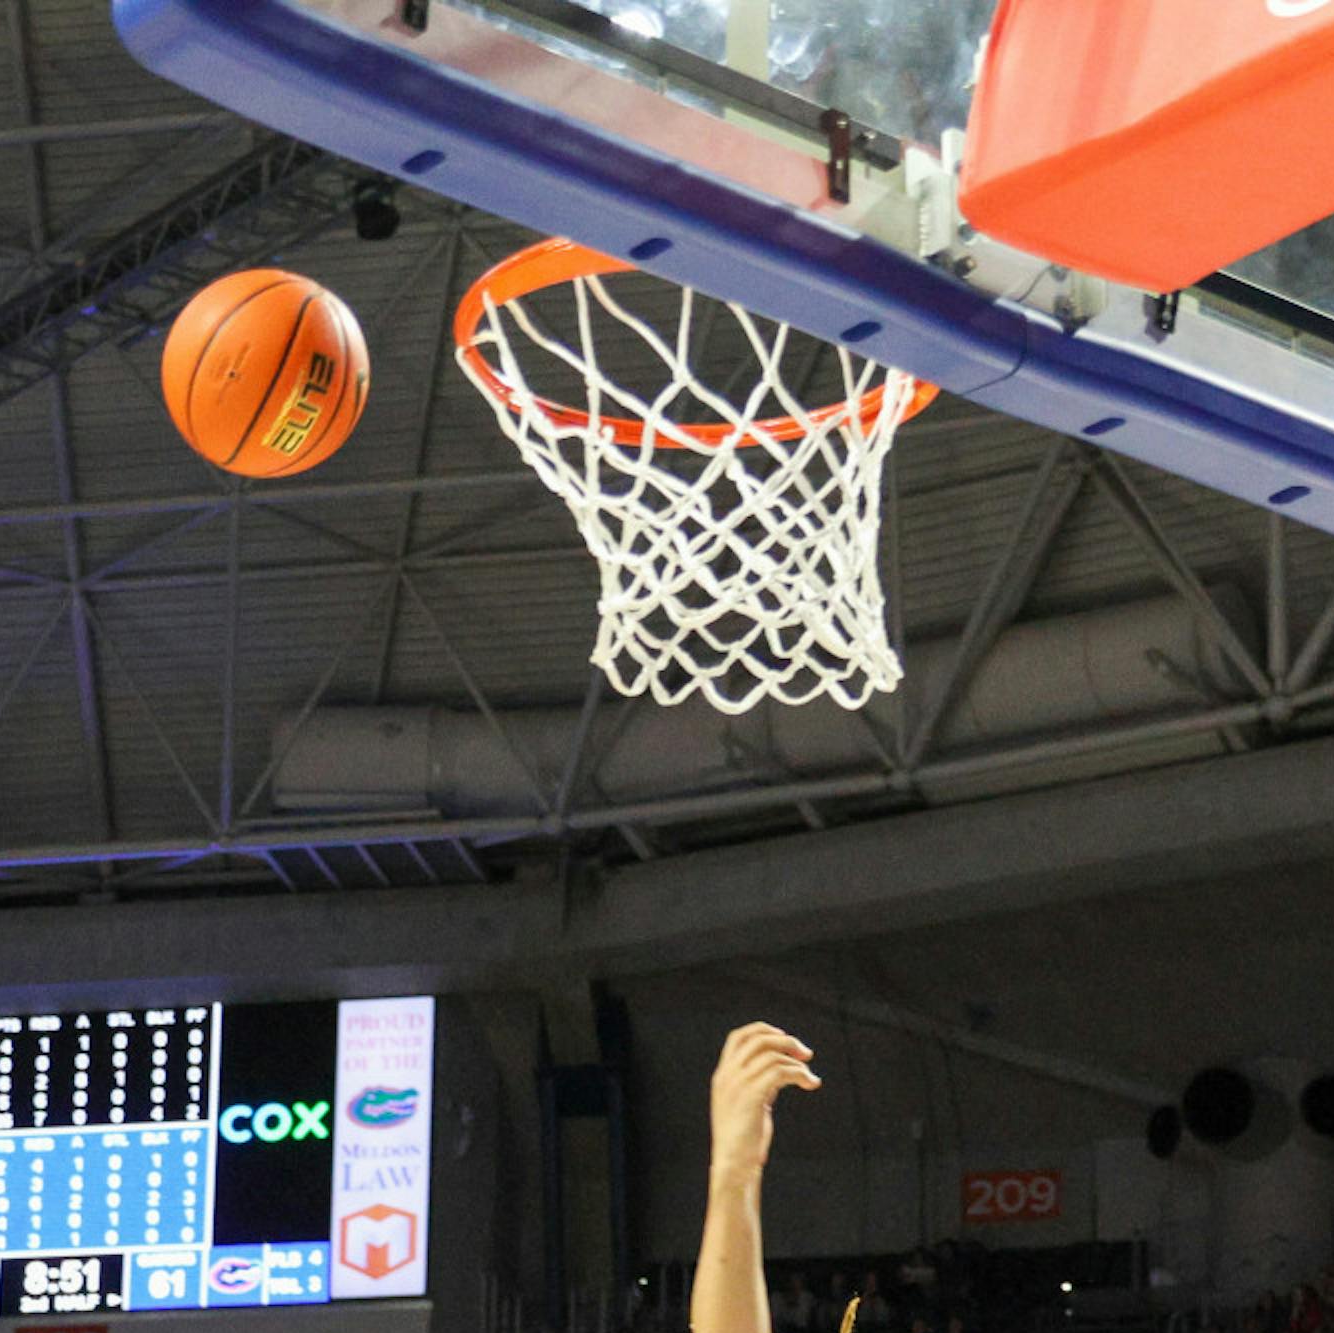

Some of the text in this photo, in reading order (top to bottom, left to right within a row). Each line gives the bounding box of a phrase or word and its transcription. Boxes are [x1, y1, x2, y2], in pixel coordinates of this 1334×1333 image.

[270, 351, 336, 454] ELITE
[219, 1102, 329, 1143] COX
[342, 1162, 421, 1192] LAW
[966, 1176, 1056, 1216] 209
[24, 1259, 100, 1295] 8:51
[148, 1269, 186, 1299] 61
